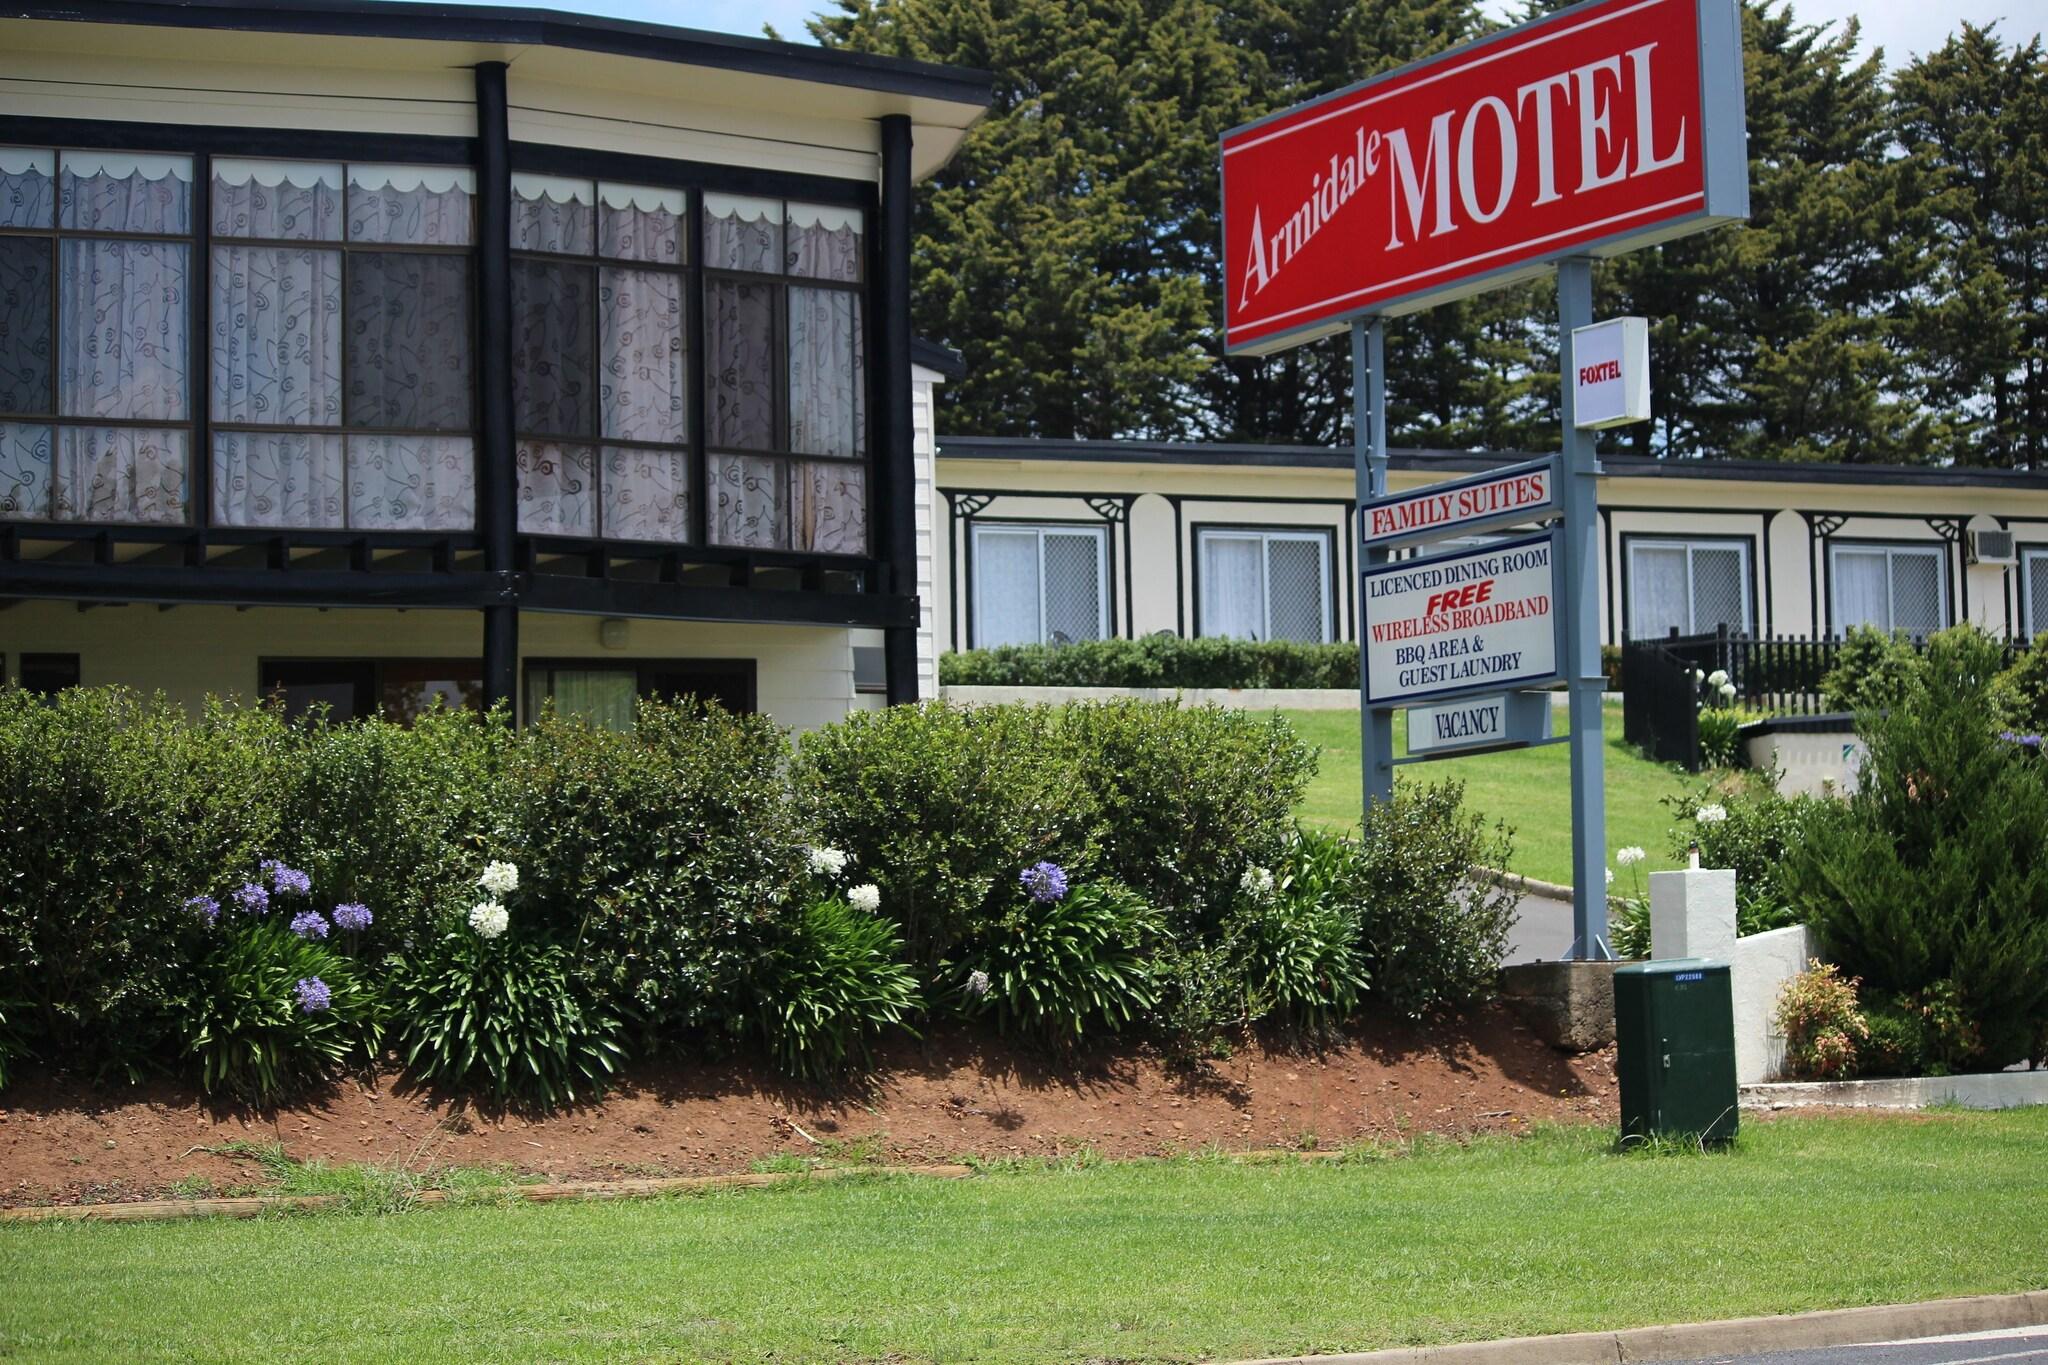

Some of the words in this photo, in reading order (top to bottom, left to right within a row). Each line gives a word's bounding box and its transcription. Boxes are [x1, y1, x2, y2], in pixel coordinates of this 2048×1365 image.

[1237, 126, 1381, 313] Armidale
[1383, 41, 1686, 251] MOTEL
[1580, 360, 1621, 386] FOXTEL
[1372, 495, 1452, 535] FAMILY
[1458, 475, 1544, 517] SUITES
[1371, 569, 1442, 598] LICENCED
[1445, 558, 1499, 584] DINING
[1502, 548, 1548, 574] ROOM
[1426, 579, 1494, 615] FREE
[1372, 613, 1450, 643] WIRELESS
[1452, 595, 1549, 630] BROADBAND
[1396, 645, 1425, 665] BBQ
[1428, 639, 1469, 661] AREA
[1473, 635, 1484, 652] &
[1399, 665, 1447, 688] GUEST
[1451, 652, 1522, 680] LAUNDRY
[1436, 706, 1500, 740] VACANCY
